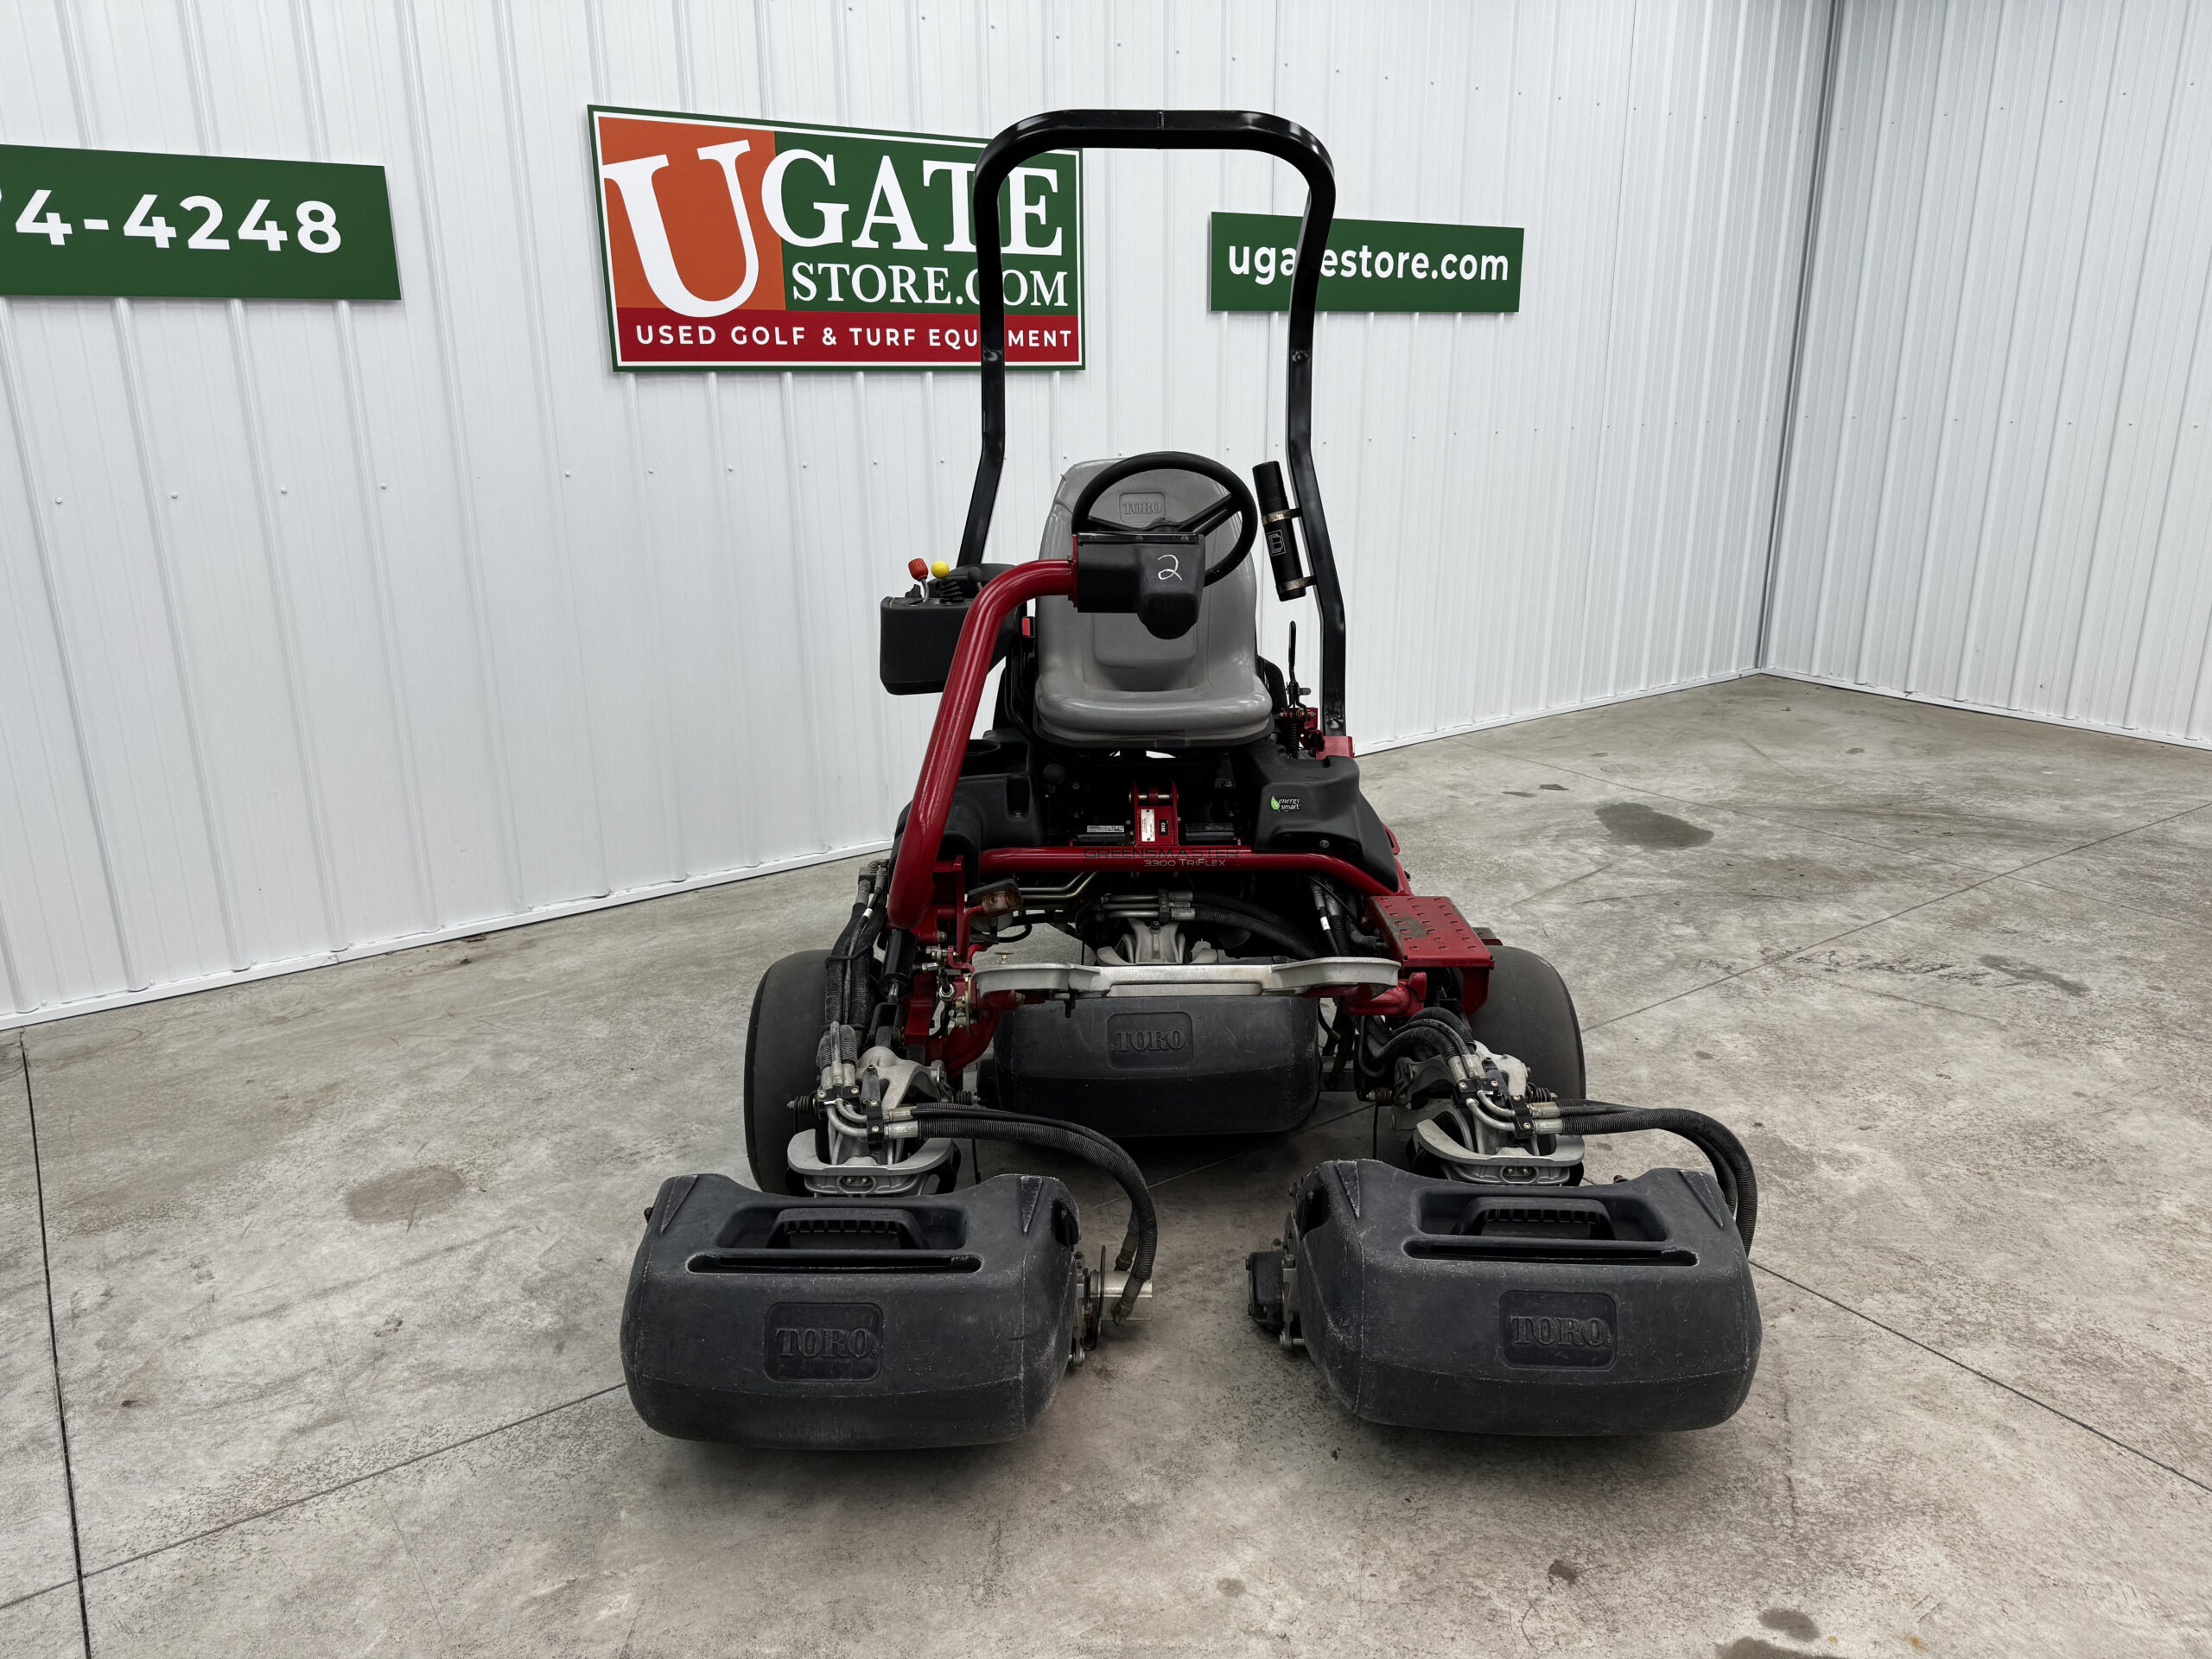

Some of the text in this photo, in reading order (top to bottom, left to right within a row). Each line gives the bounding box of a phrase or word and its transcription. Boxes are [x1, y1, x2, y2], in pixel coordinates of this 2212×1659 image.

[0, 188, 342, 254] 4-4248
[1229, 245, 1509, 286] ugaestore.com
[636, 324, 1072, 351] USED GOLF & TURF EQUMENT
[1123, 502, 1162, 515] TORO
[1157, 554, 1183, 581] 2
[1084, 848, 1241, 859] GREENSMASTER
[1114, 1029, 1187, 1052] TORO
[775, 1328, 874, 1357] TORO
[1509, 1316, 1610, 1346] TORO
